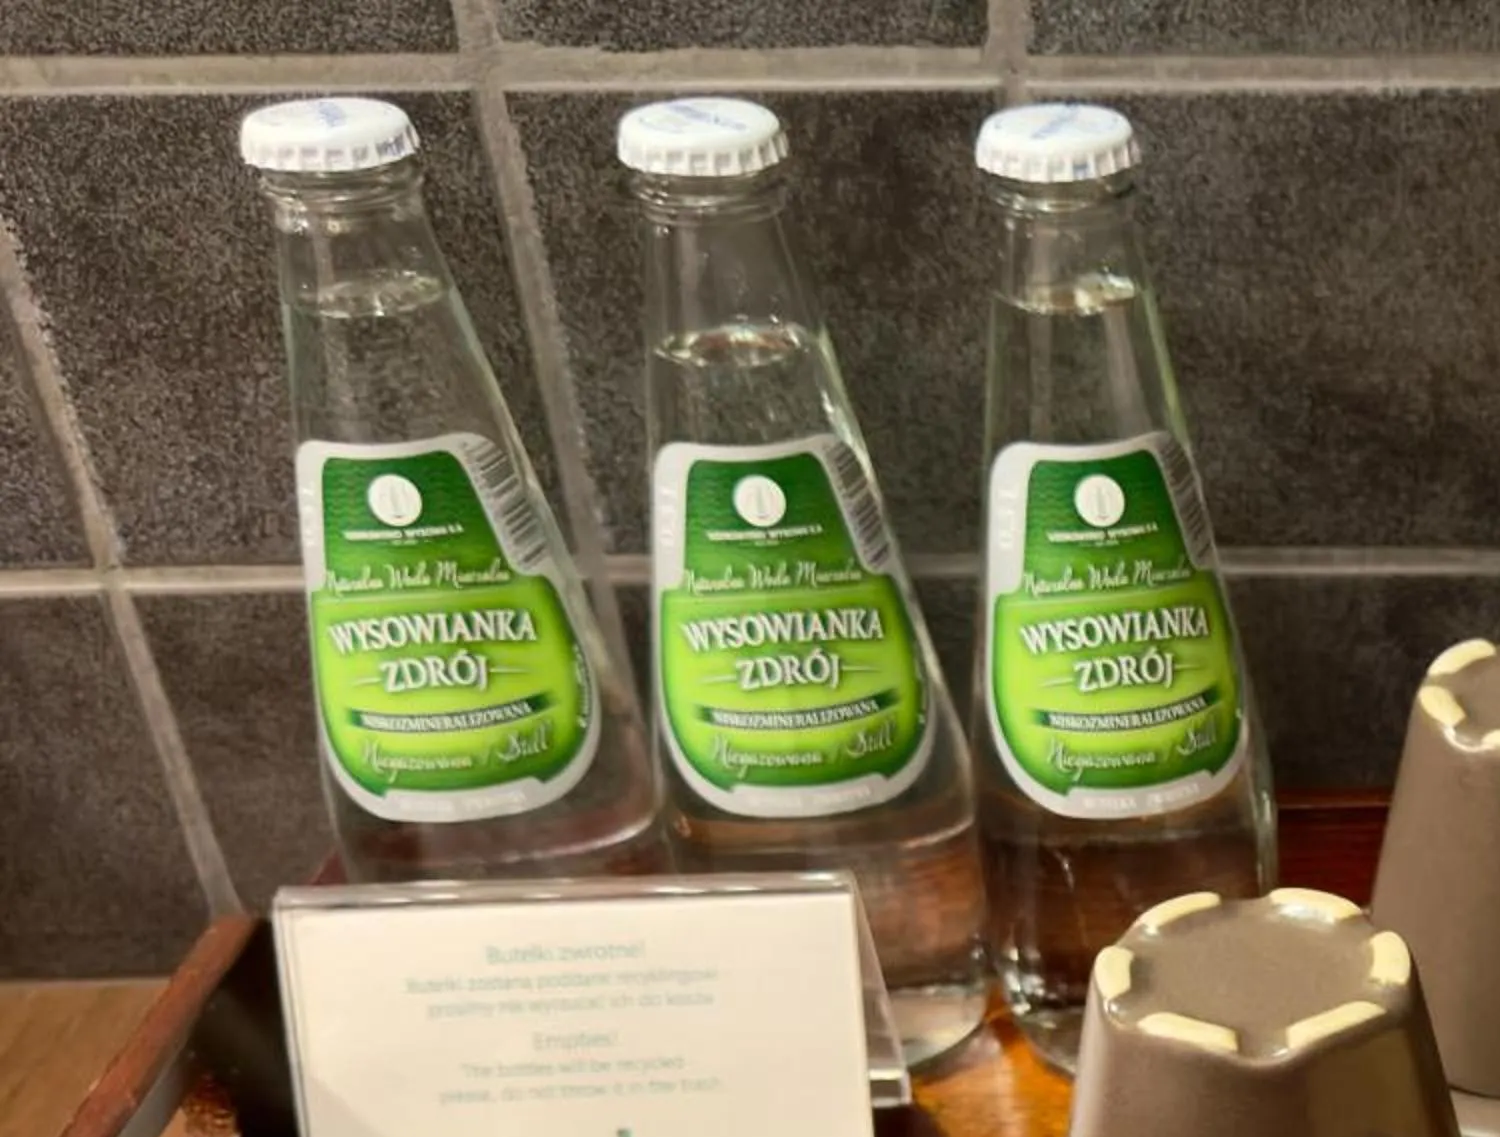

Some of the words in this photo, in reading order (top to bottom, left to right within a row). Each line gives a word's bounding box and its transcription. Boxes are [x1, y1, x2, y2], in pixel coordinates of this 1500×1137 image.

[329, 609, 537, 654] WYSOWIANKA
[681, 608, 884, 652] WYSOWIANKA
[1019, 607, 1209, 654] WYSOWIANKA
[379, 649, 488, 692] ZDRÓJ
[736, 648, 841, 690] ZDRÓJ
[1074, 646, 1174, 692] ZDRÓJ
